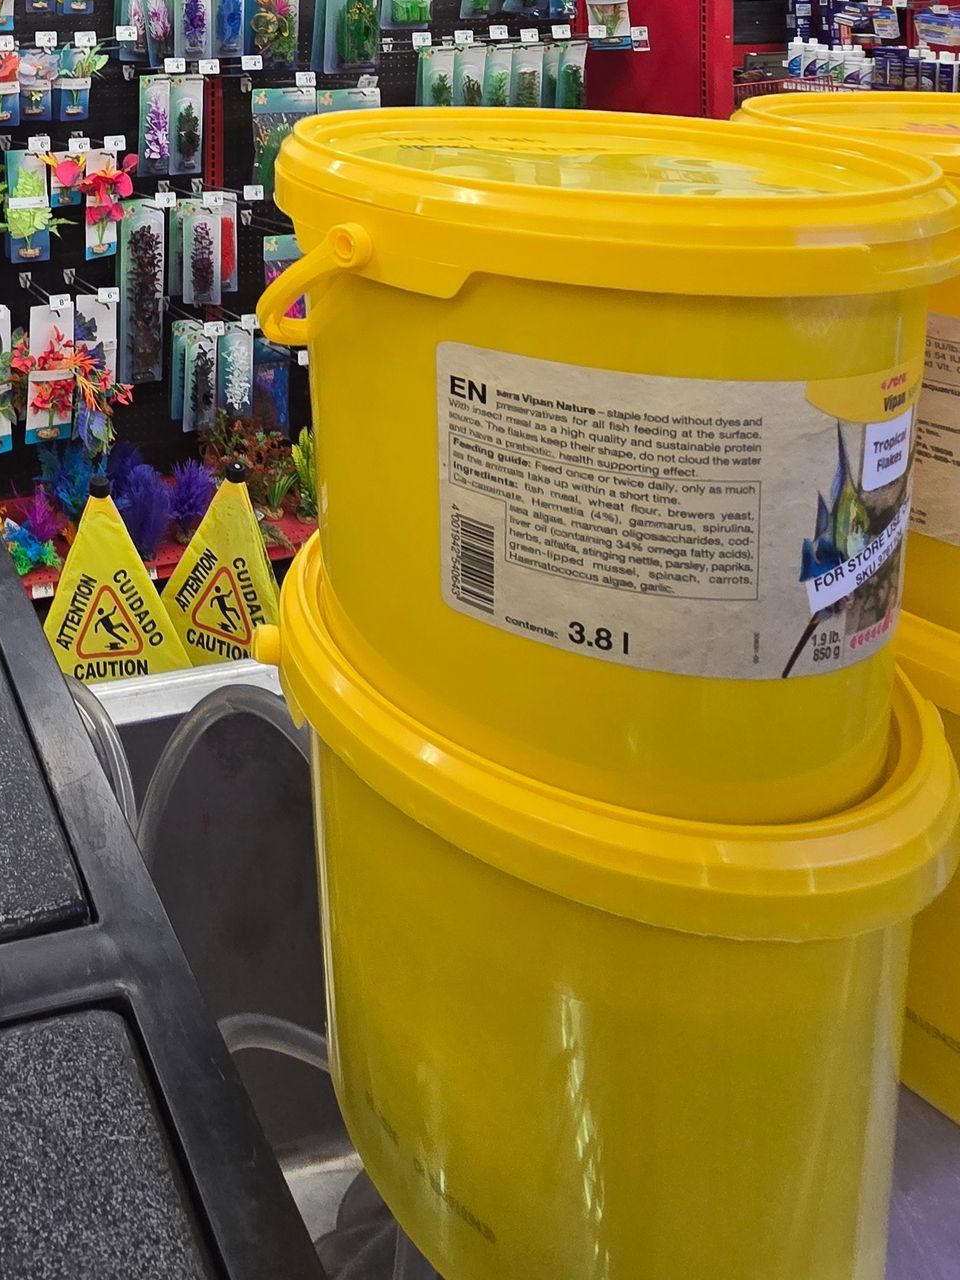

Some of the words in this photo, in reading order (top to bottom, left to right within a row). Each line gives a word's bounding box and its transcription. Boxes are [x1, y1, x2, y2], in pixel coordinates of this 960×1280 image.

[449, 374, 487, 404] EN
[448, 397, 470, 411] With
[472, 406, 503, 420] insect
[506, 415, 532, 428] meal
[534, 423, 547, 431] as
[550, 426, 557, 434] a
[560, 425, 585, 439] high
[588, 433, 627, 447] quality
[630, 438, 652, 448] and
[656, 440, 721, 452] sustainable
[724, 443, 762, 454] protein
[496, 400, 568, 423] preservatives
[572, 416, 588, 426] for
[592, 419, 604, 429] all
[609, 422, 629, 432] fish
[634, 425, 677, 439] feeding
[681, 430, 692, 438] at
[697, 430, 715, 439] the
[522, 394, 553, 408] Vipan
[556, 400, 596, 415] Nature
[607, 410, 641, 420] staple
[644, 413, 669, 424] food
[672, 416, 712, 426] without
[715, 419, 740, 429] dyes
[743, 417, 762, 426] and
[449, 422, 466, 434] and
[469, 429, 493, 443] have
[559, 450, 594, 465] health
[597, 456, 660, 477] supporting
[663, 467, 698, 478] effect.
[487, 420, 505, 433] The
[540, 434, 568, 448] keep
[570, 441, 596, 453] their
[639, 452, 655, 461] do
[657, 453, 676, 463] not
[678, 455, 710, 465] cloud
[712, 457, 730, 466] the
[732, 457, 762, 466] water
[873, 427, 907, 454] Tropical
[453, 437, 494, 458] Feeding
[497, 452, 532, 468] guide:
[535, 460, 563, 474] Feed
[566, 469, 594, 482] once
[598, 474, 610, 483] or
[613, 475, 645, 489] twice
[681, 485, 706, 495] only
[708, 486, 722, 494] as
[725, 486, 756, 495] much
[877, 450, 902, 472] Flakes
[453, 461, 518, 488] Ingredients:
[524, 482, 544, 495] fish
[588, 498, 624, 512] wheat
[667, 508, 715, 520] brewers
[528, 471, 551, 484] take
[554, 478, 569, 490] up
[572, 482, 606, 495] within
[609, 490, 617, 498] a
[619, 489, 649, 502] short
[652, 494, 681, 505] time.
[509, 516, 532, 529] liver
[534, 523, 548, 532] oil
[550, 527, 612, 548] (containing
[647, 546, 687, 558] omega
[690, 548, 715, 560] fatty
[509, 540, 584, 567] green-lipped
[728, 537, 754, 547] cod-
[509, 551, 599, 583] Haematococcus
[582, 547, 626, 564] stinging
[814, 567, 845, 592] FOR
[848, 538, 888, 573] STORE
[174, 548, 218, 612] ATTENTION
[855, 562, 876, 586] SKU
[113, 569, 164, 647] CUIDADO
[233, 558, 266, 627] CUIDA
[56, 574, 98, 650] ATTENTION
[505, 616, 559, 639] contents:
[568, 621, 613, 651] 3.8
[812, 632, 827, 647] 1.9
[829, 631, 841, 644] lb.
[73, 659, 148, 680] CAUTION
[813, 646, 832, 661] 850
[834, 647, 840, 660] g
